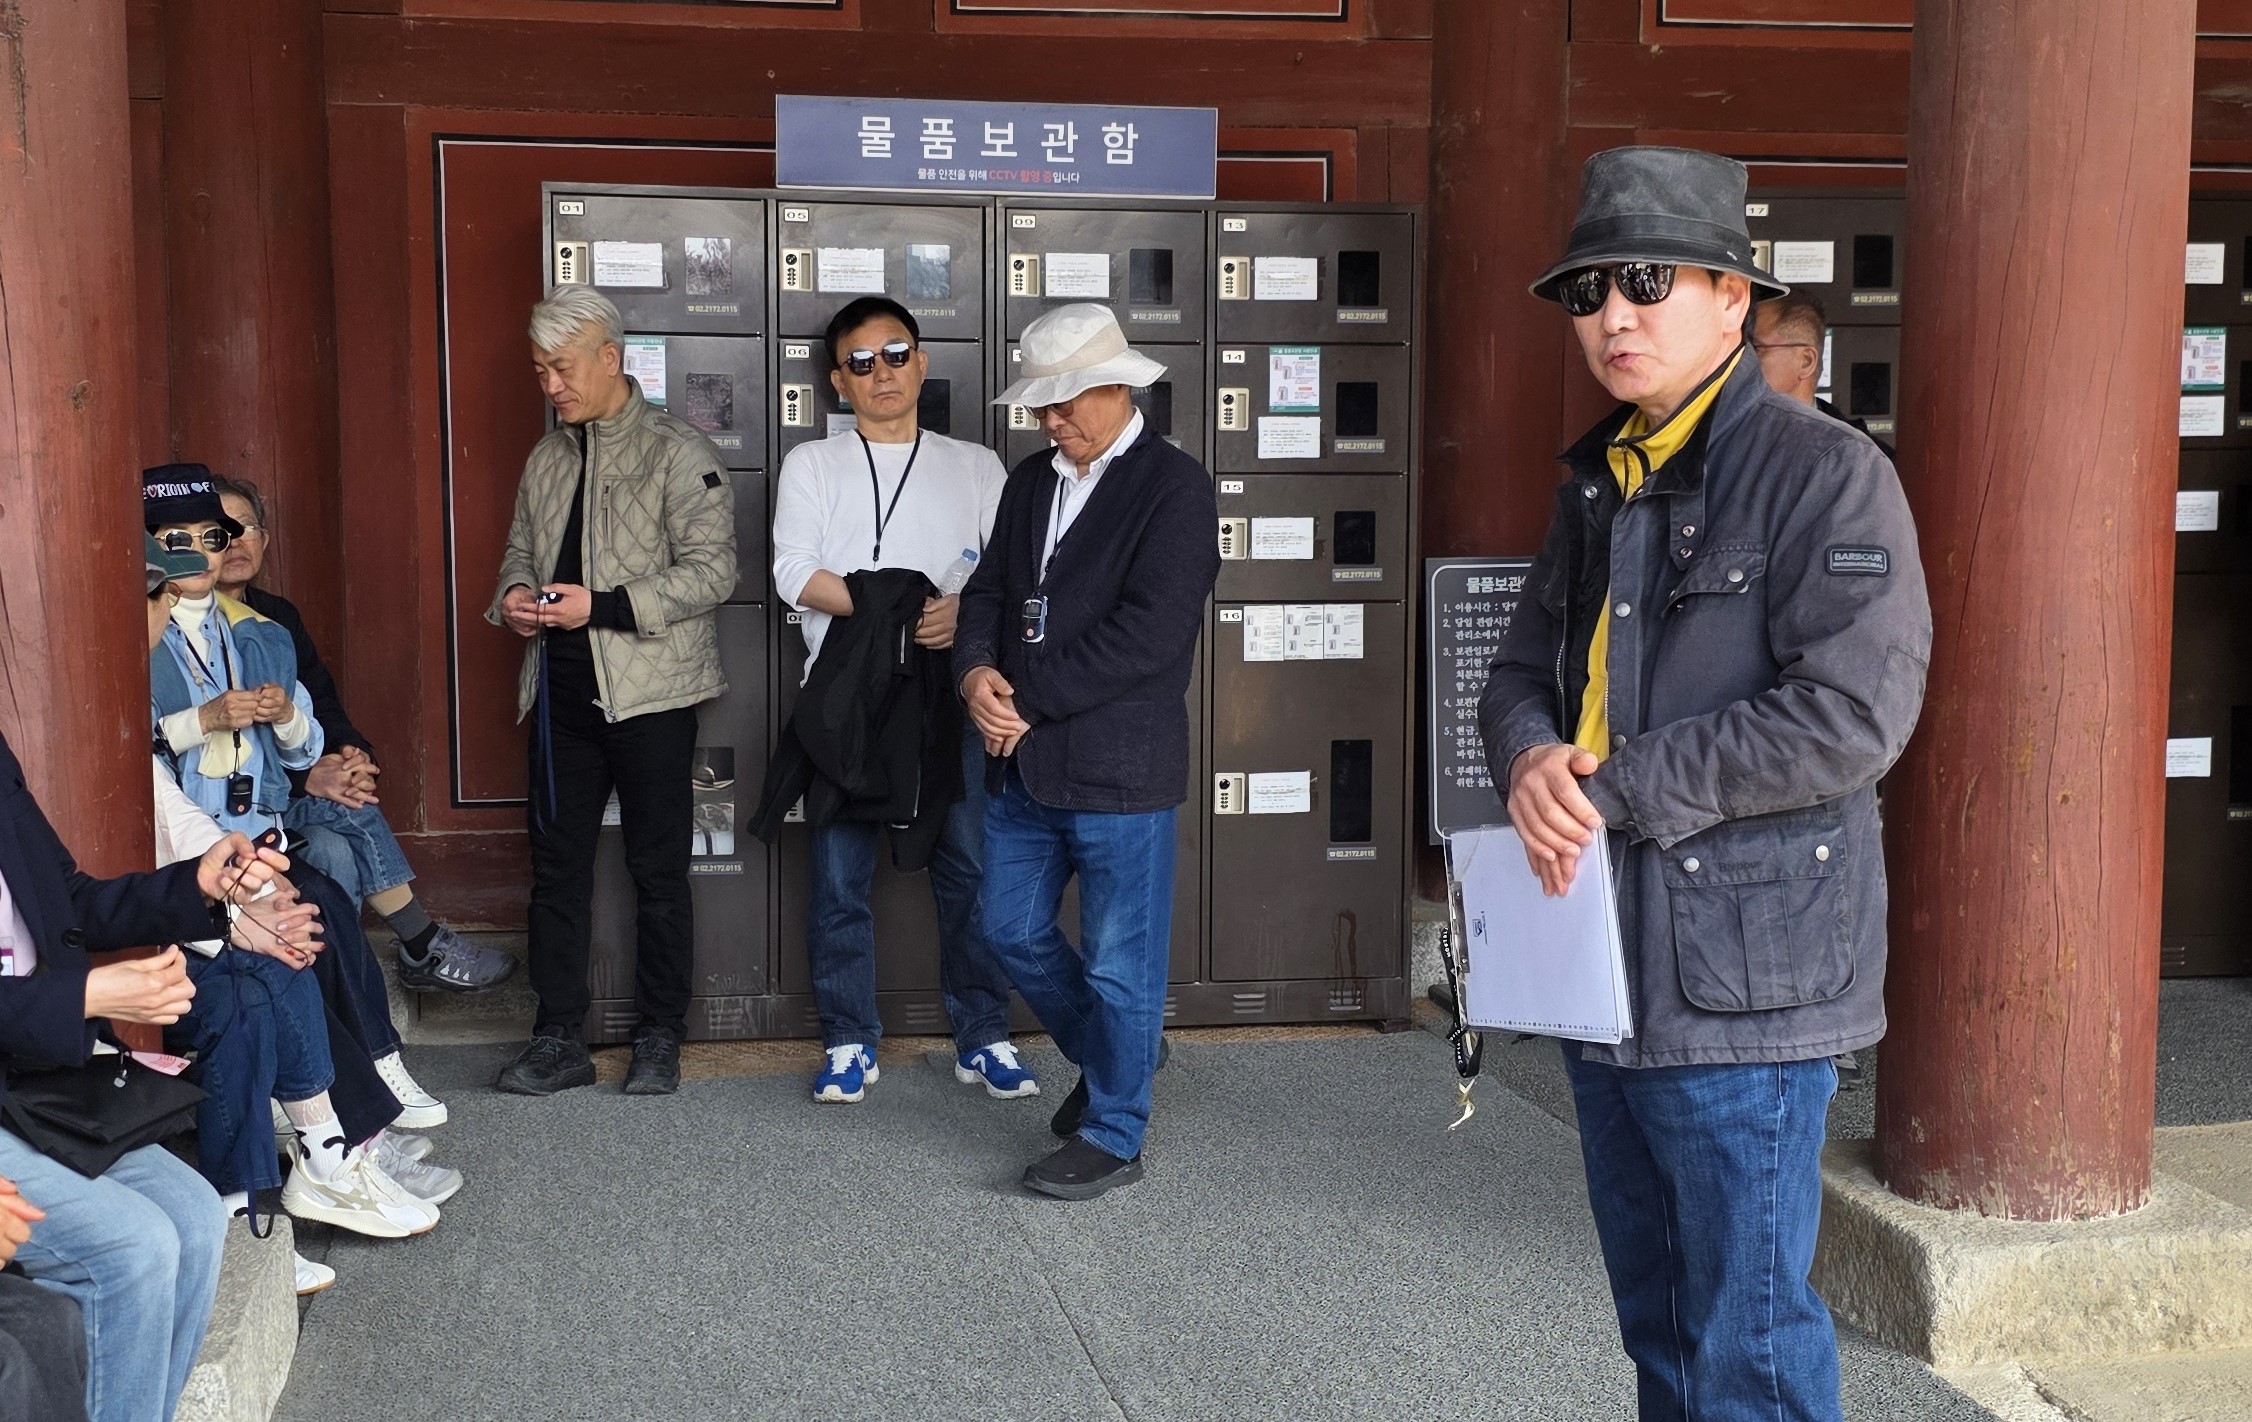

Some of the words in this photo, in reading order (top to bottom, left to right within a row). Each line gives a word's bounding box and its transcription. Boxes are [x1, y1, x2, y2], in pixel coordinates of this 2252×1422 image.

[918, 168, 936, 180] 물품
[938, 168, 966, 181] 안전을
[968, 169, 987, 181] 위해
[989, 170, 1018, 181] CCTV
[561, 204, 580, 212] 01
[1748, 207, 1765, 215] 17
[786, 211, 806, 219] 05
[1015, 218, 1033, 226] 09
[695, 305, 738, 313] 02.2172.0115
[787, 348, 807, 356] 06
[1226, 353, 1242, 361] 14
[1466, 575, 1526, 593] 물품보관
[1443, 603, 1451, 613] 1.
[1455, 601, 1491, 613] 이용시간
[1442, 618, 1451, 628] 2.
[1455, 617, 1473, 628] 당일
[1455, 629, 1500, 641] 관리소에서
[1443, 647, 1451, 657] 3.
[1469, 681, 1478, 692] 수
[1443, 698, 1452, 708] 4.
[1444, 766, 1453, 776] 6.
